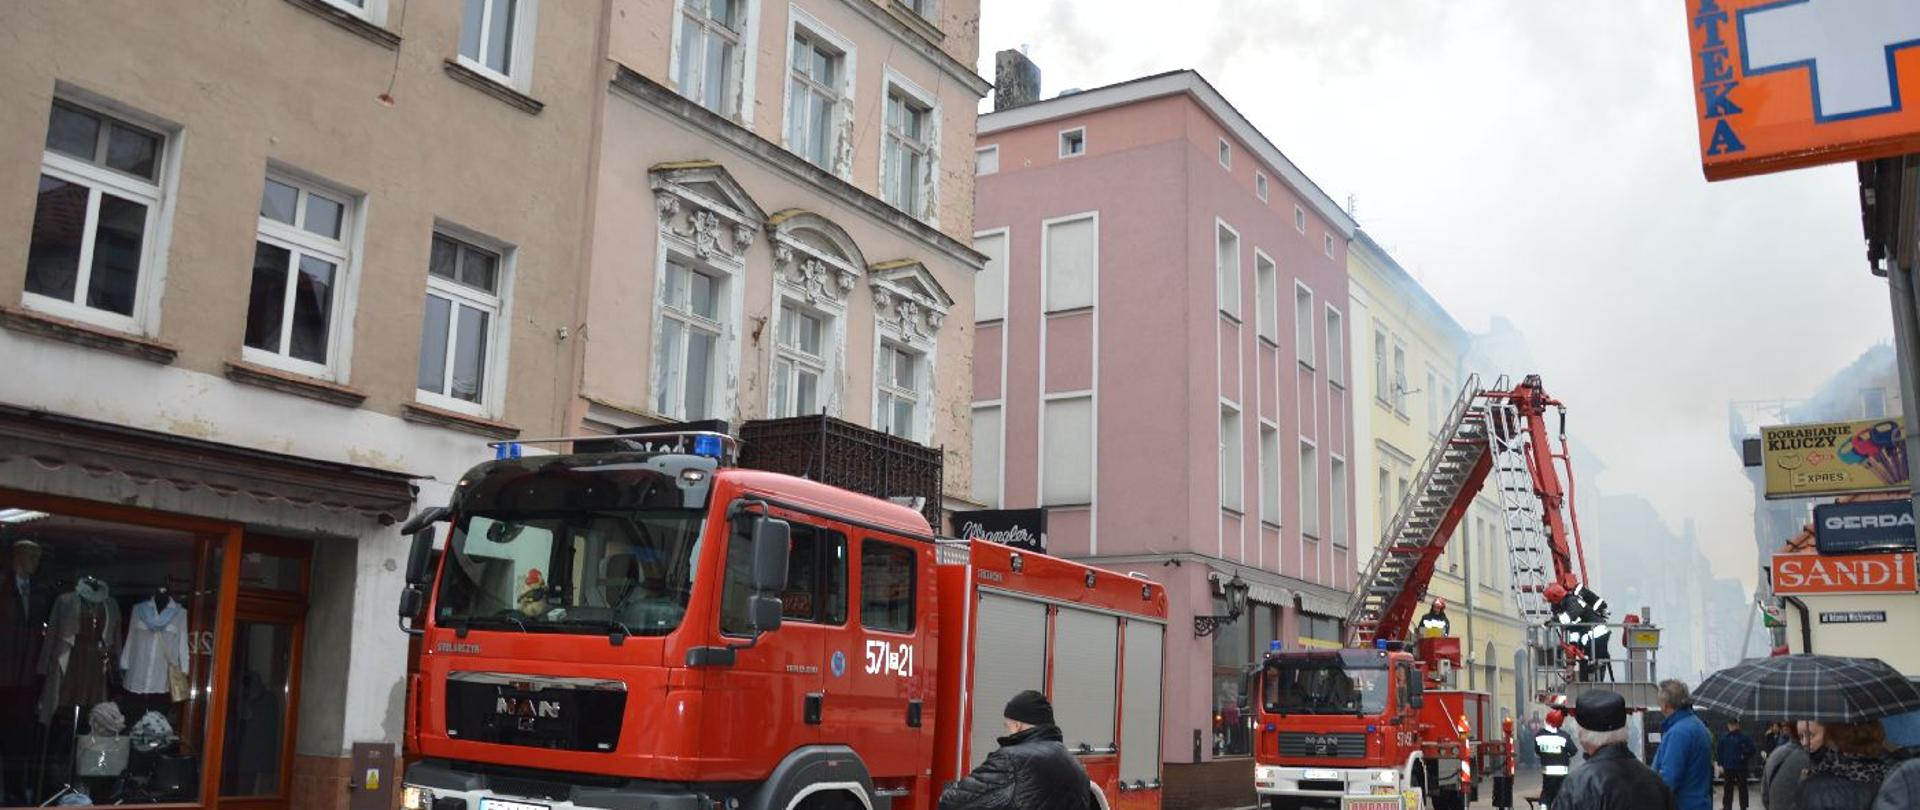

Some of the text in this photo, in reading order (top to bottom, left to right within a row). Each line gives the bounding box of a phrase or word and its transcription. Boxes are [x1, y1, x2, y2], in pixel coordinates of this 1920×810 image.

[1767, 426, 1852, 440] DORABIANIE
[1768, 436, 1838, 451] KLUCZY
[1824, 513, 1915, 530] GERDA
[496, 697, 560, 718] MAN
[1305, 736, 1338, 745] MAN
